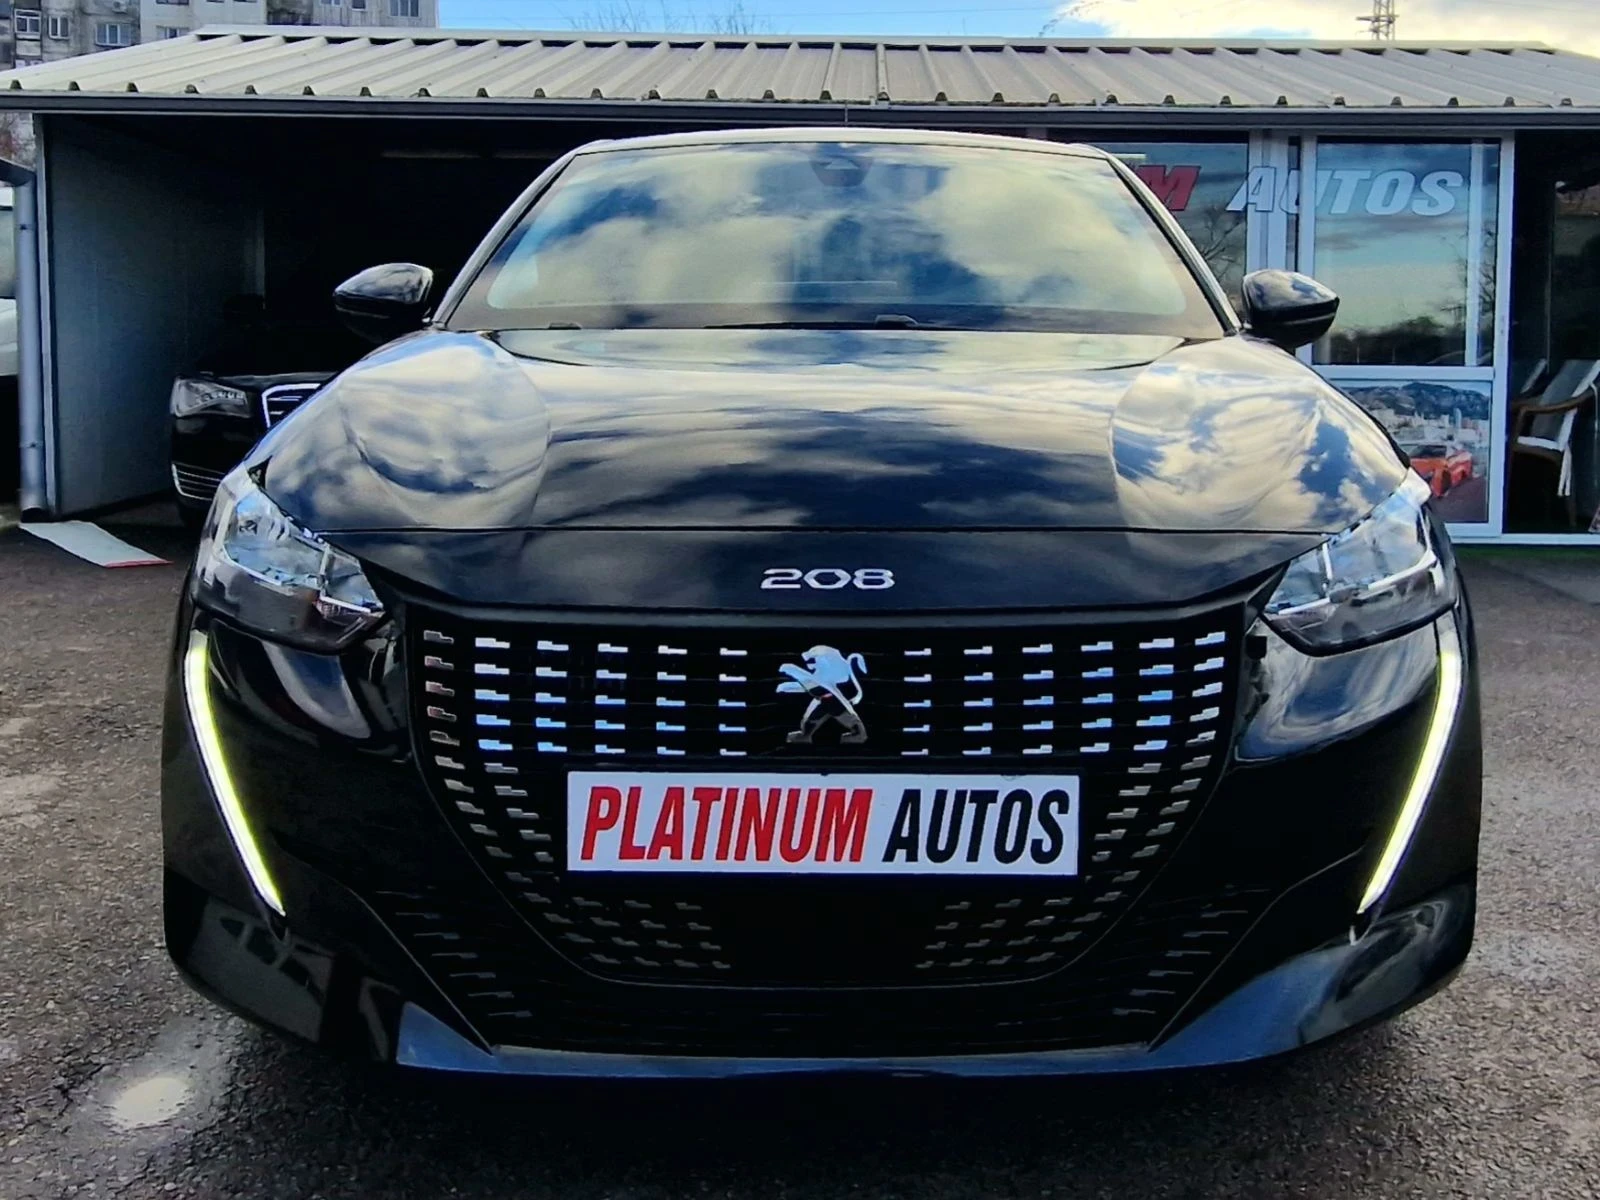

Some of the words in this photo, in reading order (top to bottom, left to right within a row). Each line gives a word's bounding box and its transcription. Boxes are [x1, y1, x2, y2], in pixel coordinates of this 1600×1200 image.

[1226, 166, 1464, 217] AUTOS
[761, 567, 896, 590] 208
[580, 786, 874, 863] PLATINUM
[882, 789, 1070, 864] AUTOS
